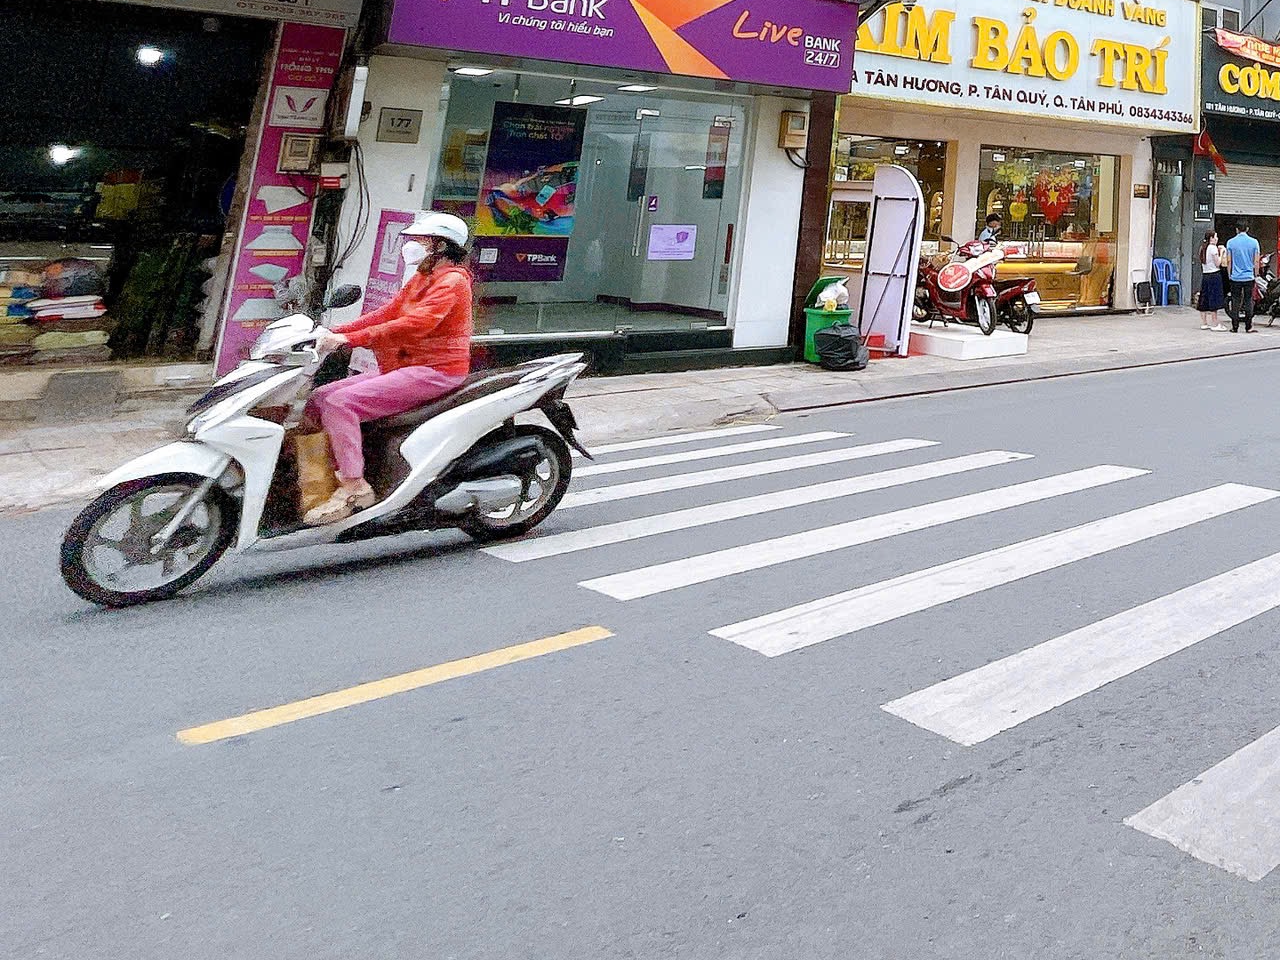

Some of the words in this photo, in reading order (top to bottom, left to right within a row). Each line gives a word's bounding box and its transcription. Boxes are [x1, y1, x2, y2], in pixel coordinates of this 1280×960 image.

[498, 12, 511, 24] Vì
[512, 15, 547, 32] chúng
[550, 19, 566, 32] tôi
[567, 21, 592, 36] hiểu
[593, 25, 614, 40] bạn
[731, 9, 804, 48] Live
[805, 36, 841, 52] BANK
[970, 7, 1080, 81] BẢO
[1090, 35, 1171, 94] TRÍ
[806, 51, 839, 67] 24/7
[1218, 62, 1280, 101] CƠM
[864, 69, 898, 88] TÂN
[903, 76, 964, 97] HƯƠNG,
[968, 85, 980, 97] P.
[984, 85, 1012, 102] TÂN
[1054, 95, 1068, 108] Q.
[1070, 97, 1095, 112] TÂN
[1099, 100, 1124, 116] PHÚ,
[1129, 105, 1194, 124] 0834343366
[390, 117, 412, 128] 177
[527, 253, 557, 262] TPBank
